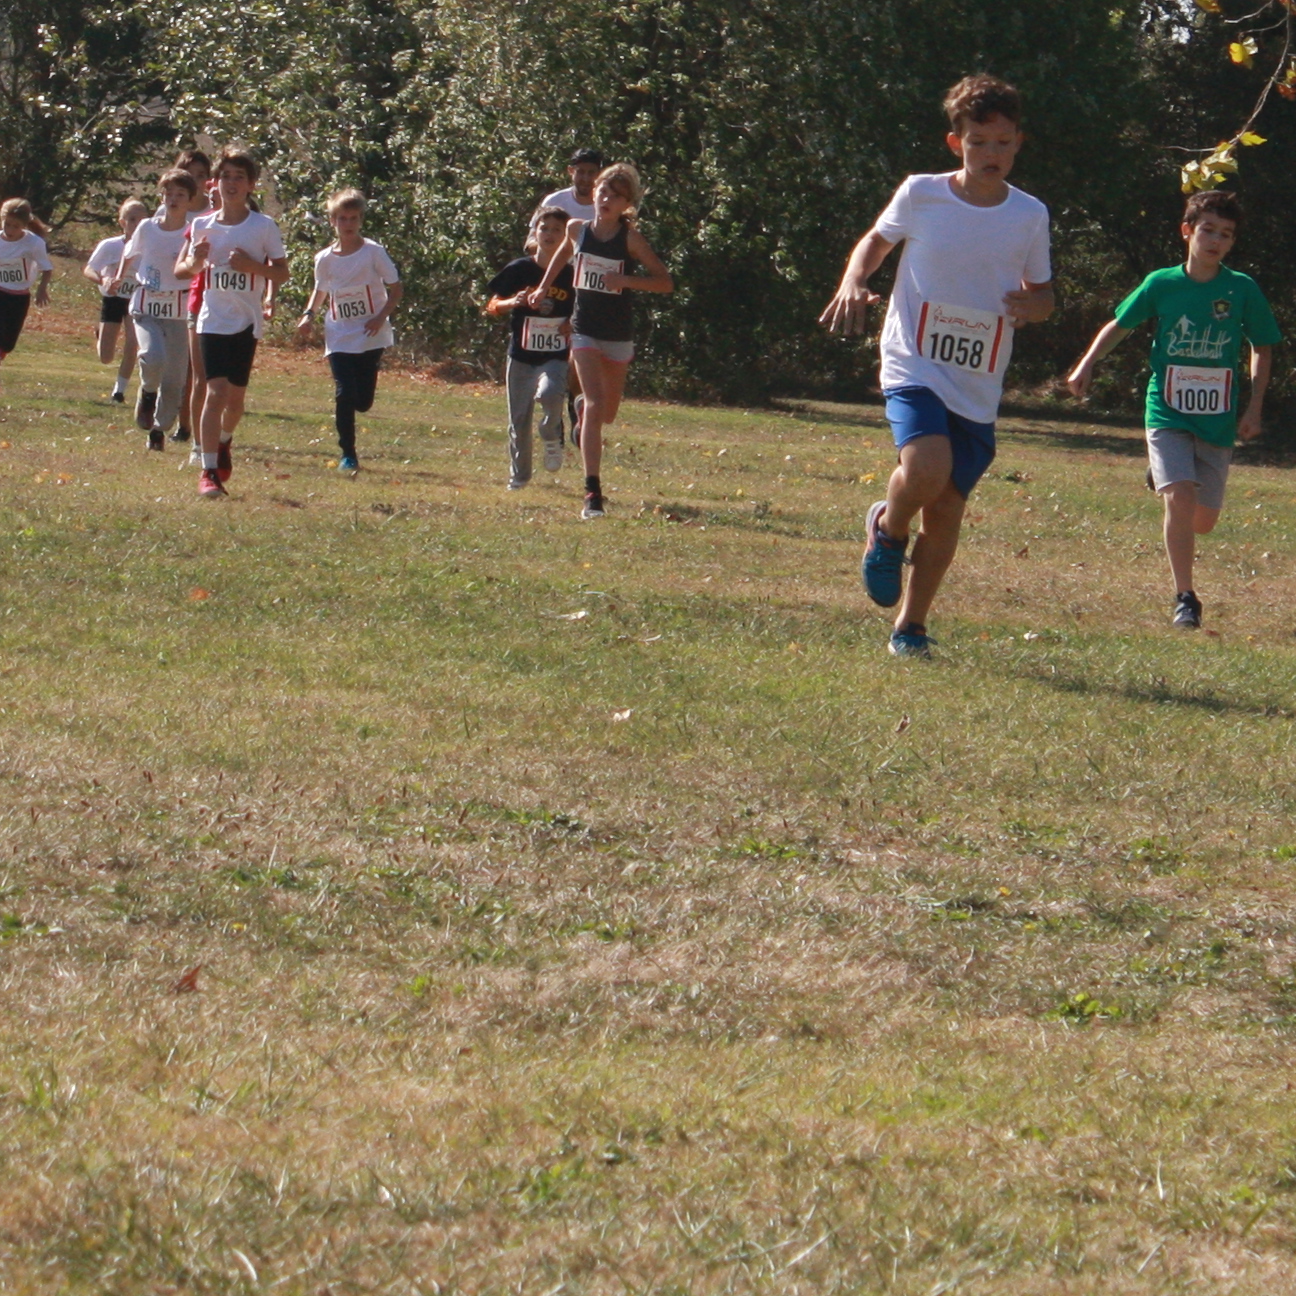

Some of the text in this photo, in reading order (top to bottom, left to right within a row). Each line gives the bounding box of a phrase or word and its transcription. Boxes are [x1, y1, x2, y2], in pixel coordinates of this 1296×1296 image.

[0, 269, 23, 283] 1060
[214, 272, 247, 290] 1049
[584, 270, 606, 290] 106
[147, 302, 173, 317] 1041
[337, 300, 367, 318] 1053
[532, 333, 561, 349] 1045
[930, 332, 985, 369] 1058
[1175, 388, 1219, 411] 1000
